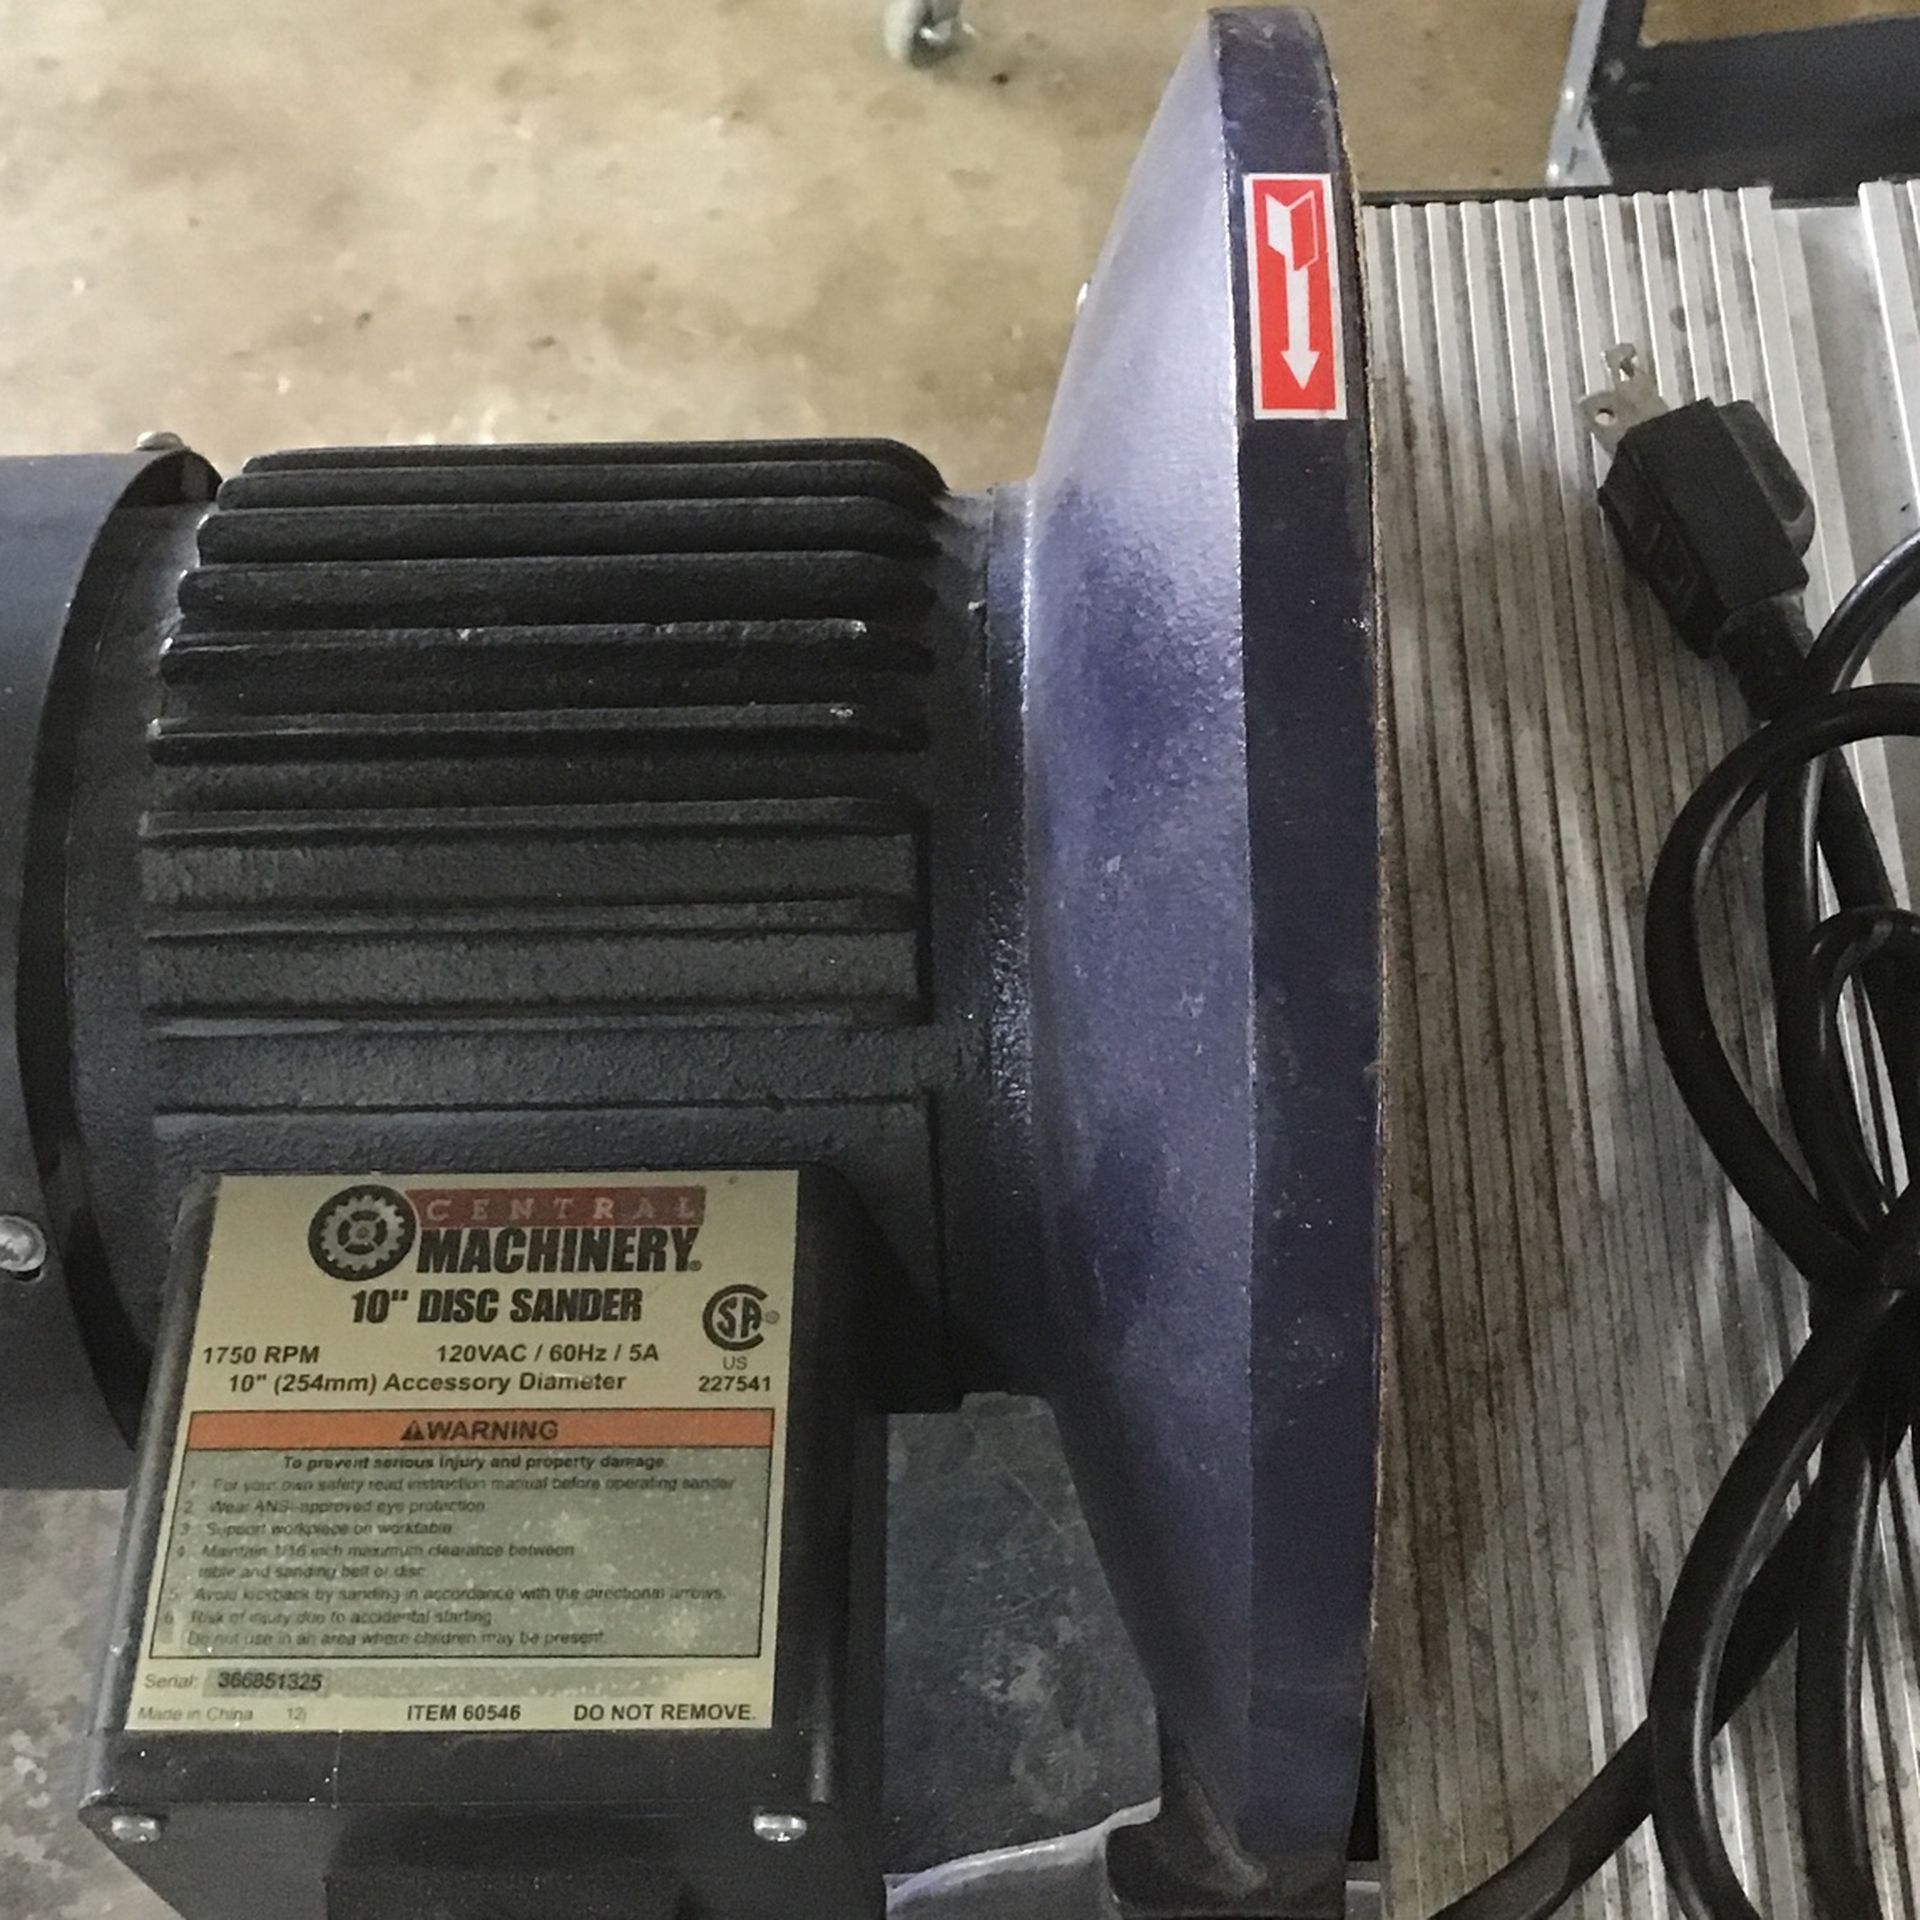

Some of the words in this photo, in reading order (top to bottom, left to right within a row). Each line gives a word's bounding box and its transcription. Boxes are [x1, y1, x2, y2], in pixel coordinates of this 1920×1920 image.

[424, 1198, 697, 1221] CENTRAL
[417, 1288, 499, 1323] DISC
[509, 1286, 644, 1322] SANDER
[202, 1345, 256, 1365] 1750
[263, 1345, 320, 1364] RPM
[436, 1343, 527, 1363] 120VAC
[549, 1344, 608, 1363] 60Hz
[627, 1344, 660, 1362] 5A
[722, 1355, 748, 1370] US
[273, 1373, 378, 1395] (254mm)
[383, 1372, 511, 1395] Accessory
[518, 1372, 627, 1392] Diameter
[698, 1376, 771, 1393] 227541
[427, 1419, 559, 1441] WARNING
[285, 1456, 302, 1469] To
[306, 1456, 368, 1472] prevent
[373, 1457, 434, 1469] serious
[439, 1455, 485, 1471] injury
[490, 1455, 521, 1468] and
[525, 1456, 595, 1471] property
[317, 1478, 363, 1494] safety
[368, 1478, 403, 1491] read
[491, 1476, 548, 1490] manual
[552, 1476, 601, 1490] before
[605, 1476, 678, 1491] operating
[377, 1502, 404, 1515] eye
[354, 1524, 373, 1535] on
[240, 1566, 270, 1578] and
[274, 1565, 337, 1580] sanding
[315, 1588, 333, 1602] by
[338, 1588, 400, 1603] sanding
[405, 1588, 419, 1600] in
[423, 1587, 514, 1600] accordance
[520, 1587, 551, 1600] with
[556, 1587, 579, 1600] the
[584, 1586, 664, 1600] directional
[229, 1611, 246, 1623] of
[330, 1611, 345, 1623] to
[244, 1633, 273, 1645] use
[278, 1632, 292, 1645] in
[321, 1633, 356, 1646] area
[361, 1632, 410, 1645] where
[481, 1633, 514, 1647] may
[520, 1631, 539, 1644] be
[137, 1707, 183, 1721] Made
[187, 1707, 201, 1721] in
[206, 1706, 254, 1721] China
[407, 1705, 457, 1721] ITEM
[462, 1705, 522, 1721] 60546
[573, 1704, 605, 1721] DO
[611, 1704, 654, 1721] NOT
